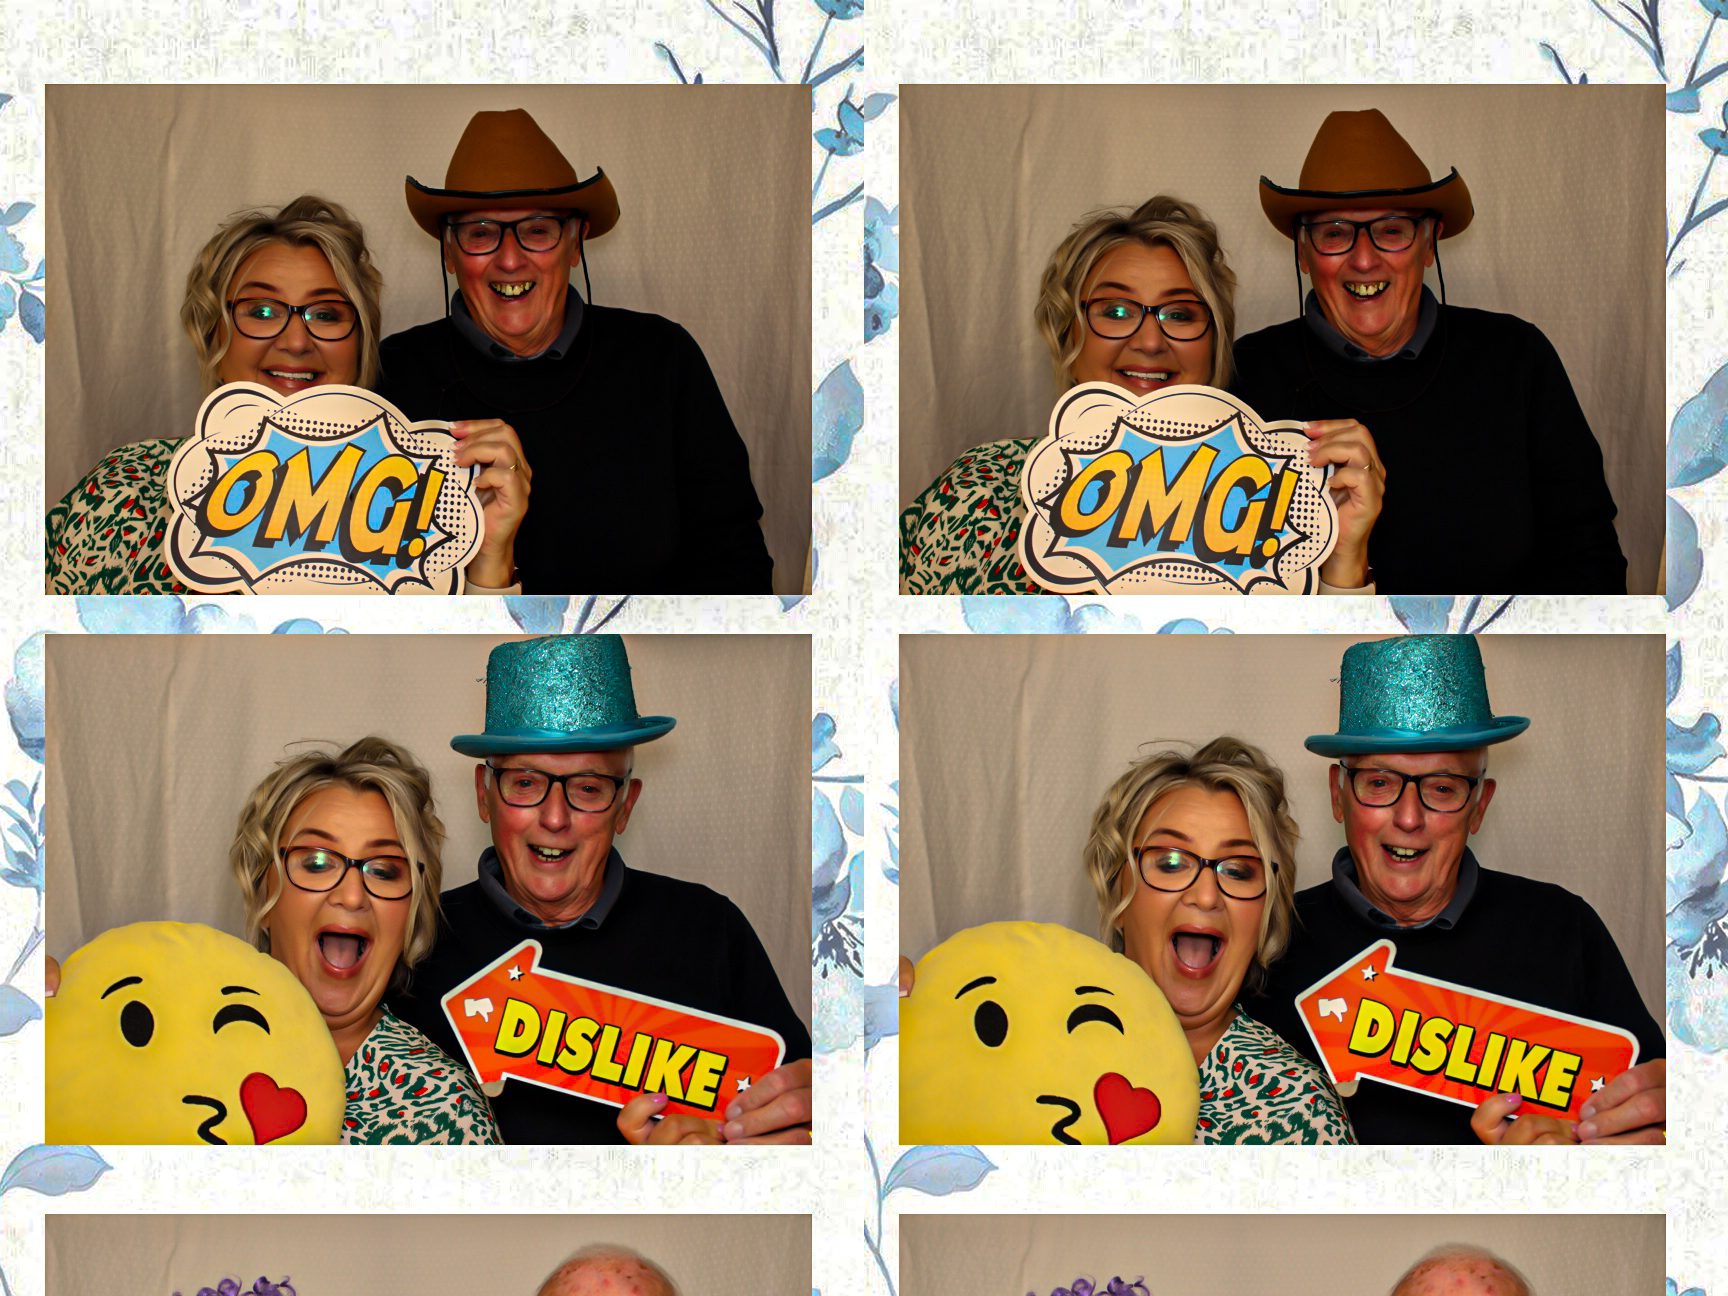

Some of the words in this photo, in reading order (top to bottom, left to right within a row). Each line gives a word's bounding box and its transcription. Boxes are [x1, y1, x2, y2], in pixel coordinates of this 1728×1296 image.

[204, 443, 446, 566] OMG!
[1058, 443, 1300, 566] OMG!
[494, 997, 729, 1112] DISLIKE
[1348, 997, 1583, 1112] DISLIKE
